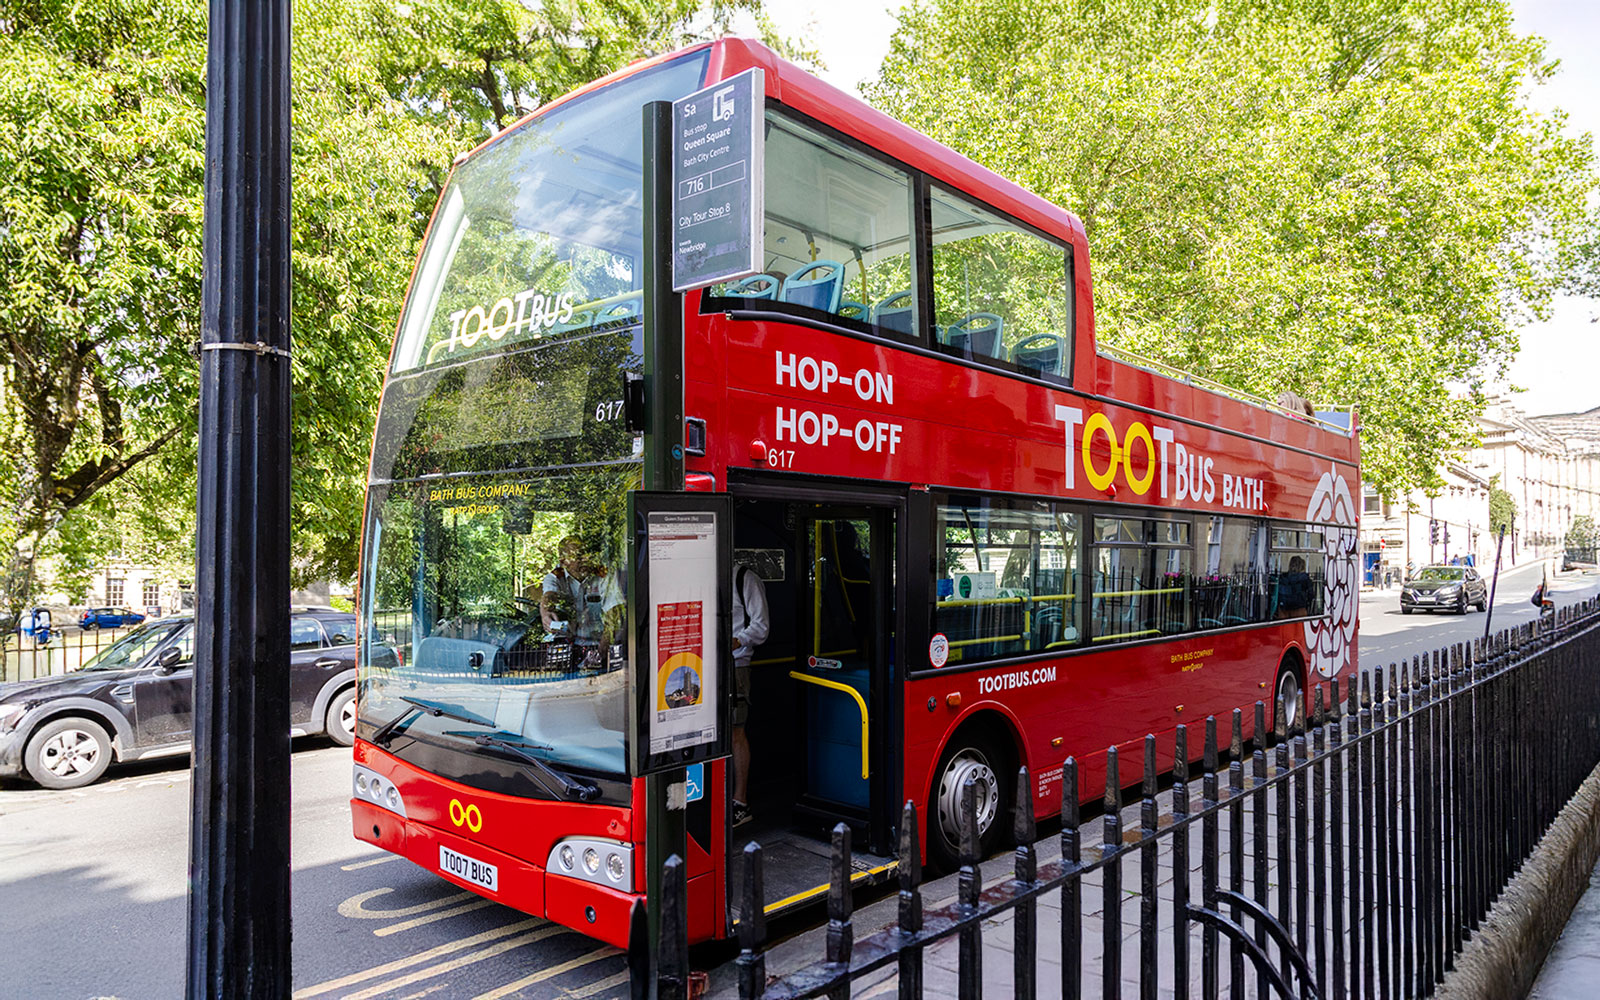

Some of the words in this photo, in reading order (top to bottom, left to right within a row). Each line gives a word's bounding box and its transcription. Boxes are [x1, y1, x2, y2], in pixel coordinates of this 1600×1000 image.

[684, 103, 697, 118] Sa
[683, 129, 694, 138] Bus
[694, 122, 708, 133] stop
[683, 141, 706, 151] Queen
[706, 127, 731, 143] Square
[683, 156, 697, 168] Bath
[697, 153, 709, 163] City
[709, 145, 730, 158] Centre
[686, 177, 704, 195] 716
[679, 216, 692, 227] City
[692, 211, 708, 222] Tour
[708, 206, 725, 218] Stop
[725, 202, 731, 213] 8
[679, 242, 707, 255] Newbridge
[775, 350, 894, 405] HOP-ON
[595, 400, 624, 422] 617
[775, 406, 903, 455] HOP-OFF
[768, 448, 795, 468] 617
[430, 489, 453, 501] BATH
[456, 487, 476, 499] BUS
[478, 483, 531, 498] COMPANY
[1222, 473, 1264, 511] BATH
[476, 505, 499, 514] GROUP
[978, 666, 1056, 694] TOOTBUS.COM
[471, 861, 493, 885] BUS
